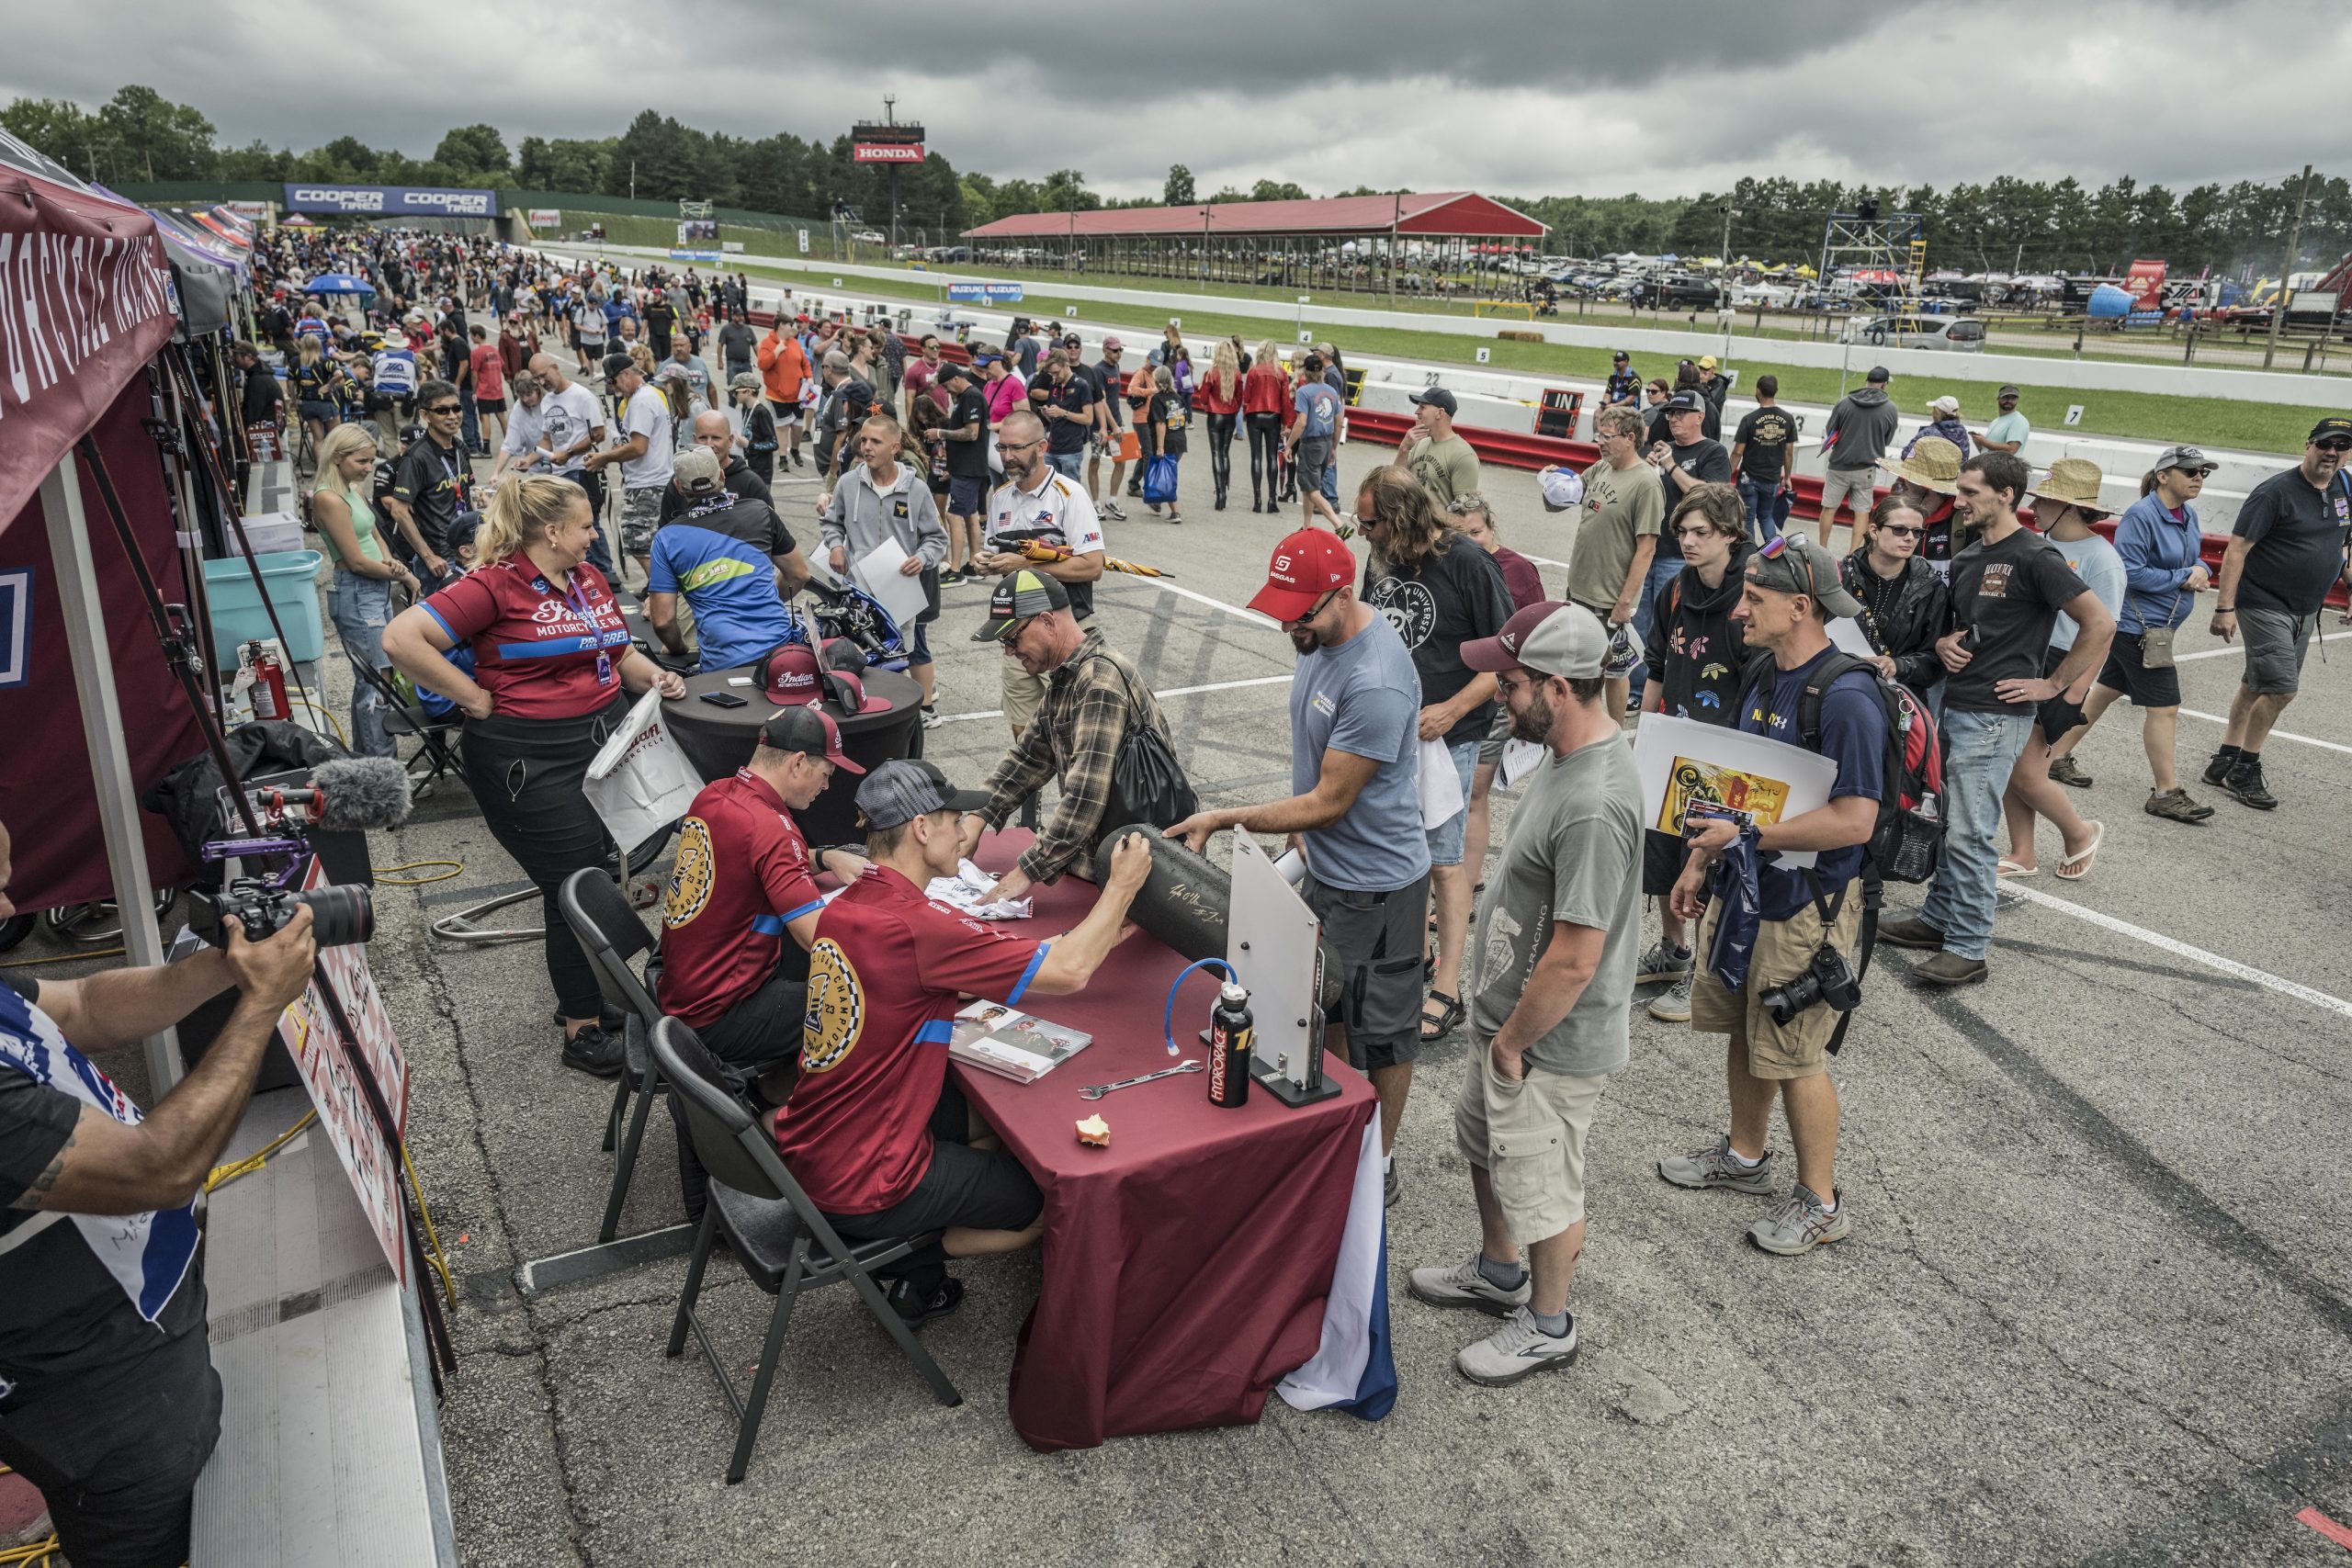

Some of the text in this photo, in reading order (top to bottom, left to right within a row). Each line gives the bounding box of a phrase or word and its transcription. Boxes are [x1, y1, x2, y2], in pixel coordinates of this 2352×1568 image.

[859, 148, 918, 159] HONDA
[294, 189, 384, 203] COOPER
[404, 192, 488, 207] COOPER
[338, 200, 383, 211] TIRES
[445, 204, 486, 214] TIRES
[950, 285, 984, 293] SUZUKI
[0, 231, 109, 418] ORCYCLE
[1302, 333, 1308, 342] 4
[1480, 352, 1487, 360] 5
[1425, 372, 1440, 387] 22
[1555, 393, 1573, 410] IN
[1756, 413, 1786, 424] MOTOR CITY
[2069, 412, 2078, 423] 7
[1588, 480, 1619, 505] URLEY
[1412, 587, 1432, 633] UNIVERSE
[536, 616, 609, 637] MOTORCYE
[778, 671, 815, 683] Indian
[1752, 708, 1777, 726] NY
[605, 736, 664, 780] MOTORCYCLE
[680, 852, 705, 912] CHAMPION
[687, 874, 695, 884] 23
[1507, 904, 1548, 1009] ELLRACING
[824, 1003, 835, 1015] 23
[826, 975, 849, 1050] CHAMPION
[1210, 1025, 1227, 1100] HYDRORACE
